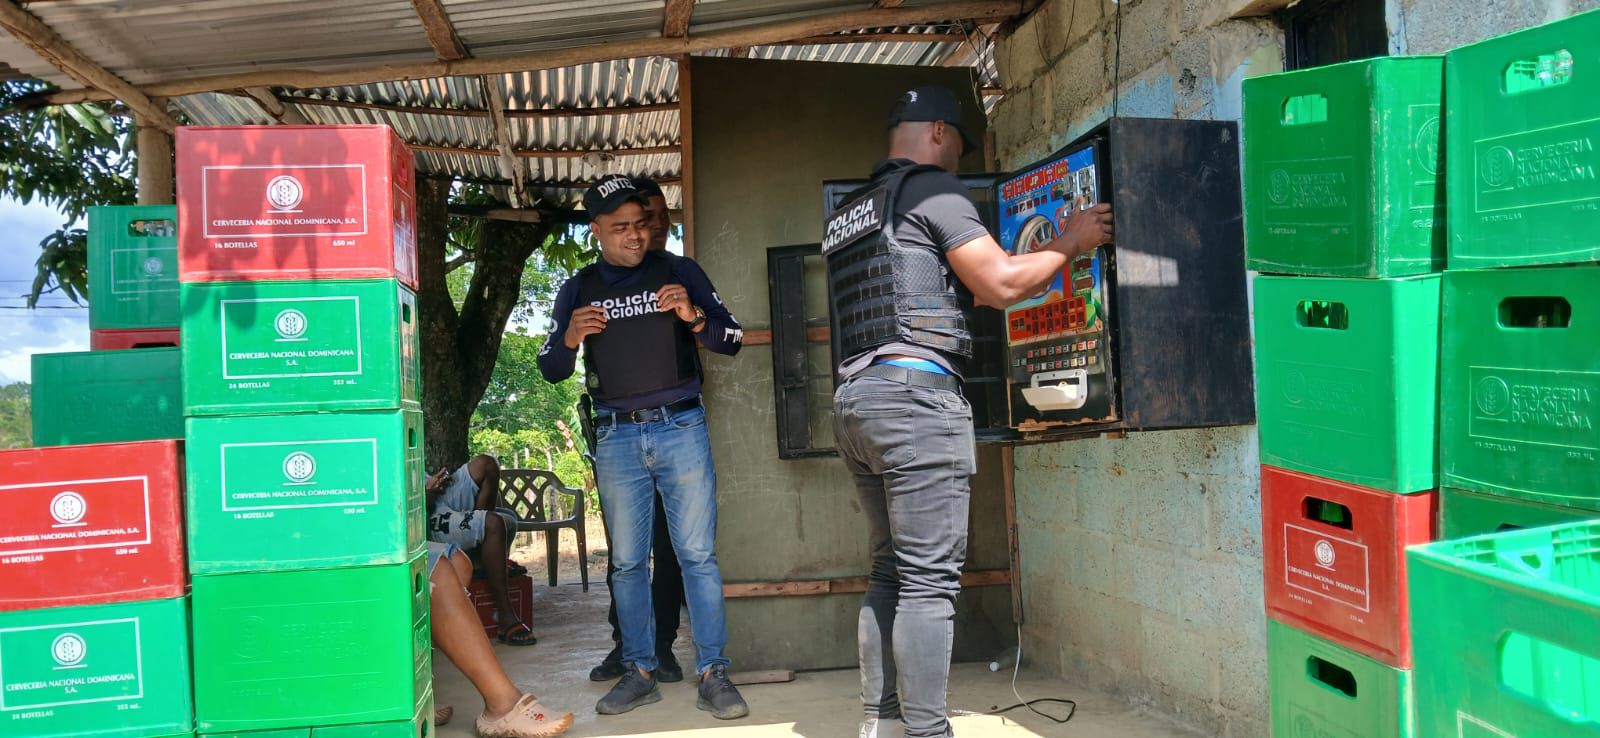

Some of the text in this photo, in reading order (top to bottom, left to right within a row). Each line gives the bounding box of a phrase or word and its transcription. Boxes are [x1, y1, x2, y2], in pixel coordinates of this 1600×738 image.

[212, 217, 358, 227] CERVECERIA NACIONAL DOMINICANA, S.A.
[827, 198, 873, 236] POLICÍA
[821, 210, 879, 255] NACIONAL
[223, 241, 258, 249] BOTELLAS
[602, 302, 661, 320] ACIONAL
[229, 349, 354, 360] CERVECERIA NACIONAL DOMINICANA
[238, 381, 271, 389] BOTELLAS
[1512, 384, 1590, 402] CERVECERIA
[1511, 410, 1592, 430] DOMINICANA
[231, 487, 367, 500] CERVECERIA NACIONAL DOMINICANA, S.A.
[242, 511, 274, 519] BOTELLAS
[0, 535, 40, 544] CERVECERIA
[40, 532, 77, 541] NACIONAL
[78, 528, 126, 538] DOMINICANA,
[10, 554, 44, 564] BOTELLAS
[5, 672, 136, 692] CERVECERIA NACIONAL DOMINICANA
[64, 686, 78, 694] S.A.
[21, 710, 54, 720] BOTELLAS
